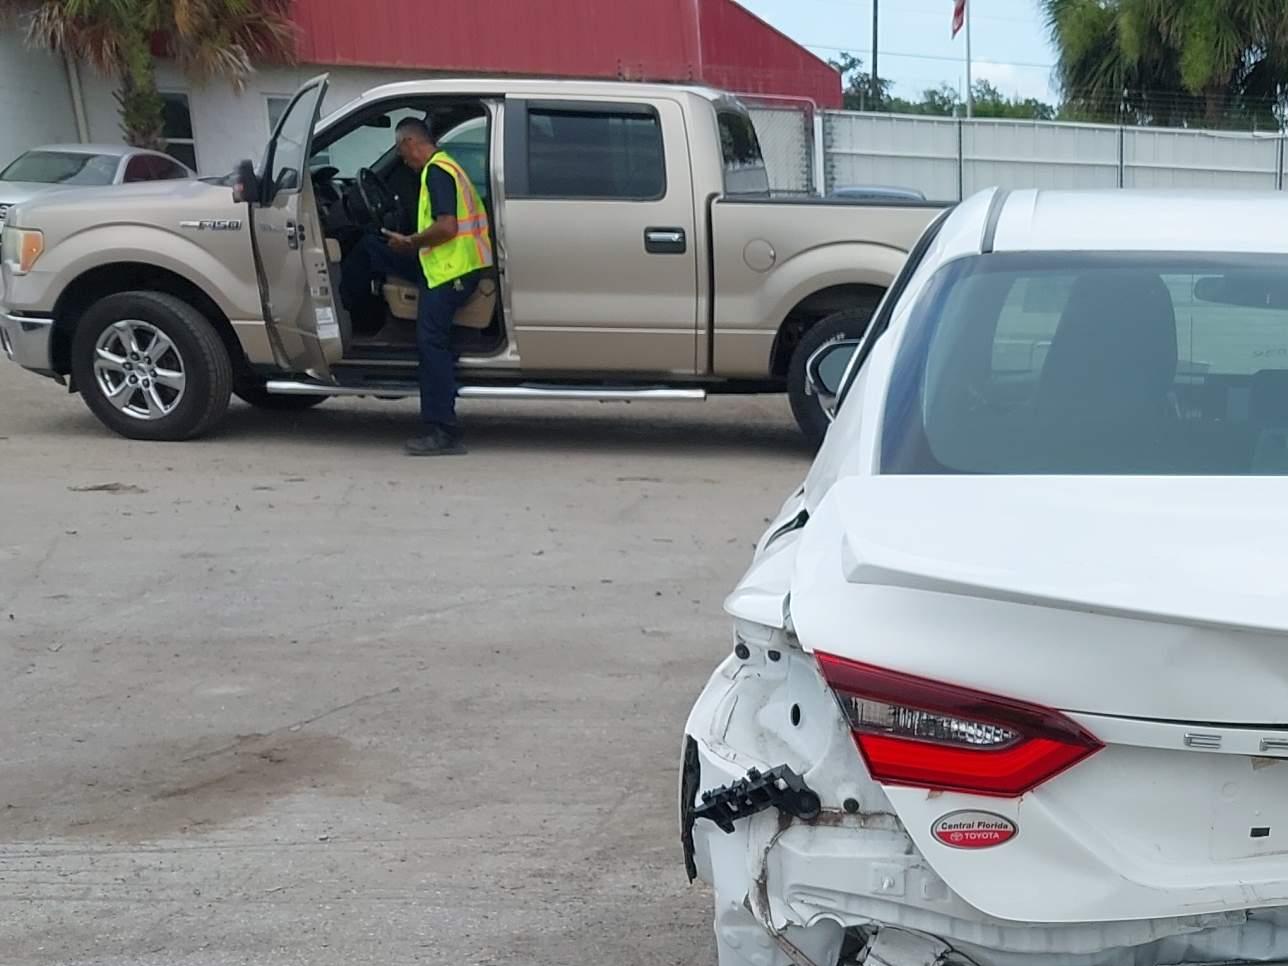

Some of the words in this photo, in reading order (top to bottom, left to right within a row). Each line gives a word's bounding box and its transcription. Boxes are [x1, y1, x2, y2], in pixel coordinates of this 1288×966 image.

[940, 821, 975, 830] Central
[977, 820, 1009, 830] Florida
[964, 831, 1000, 841] TOYOTA
